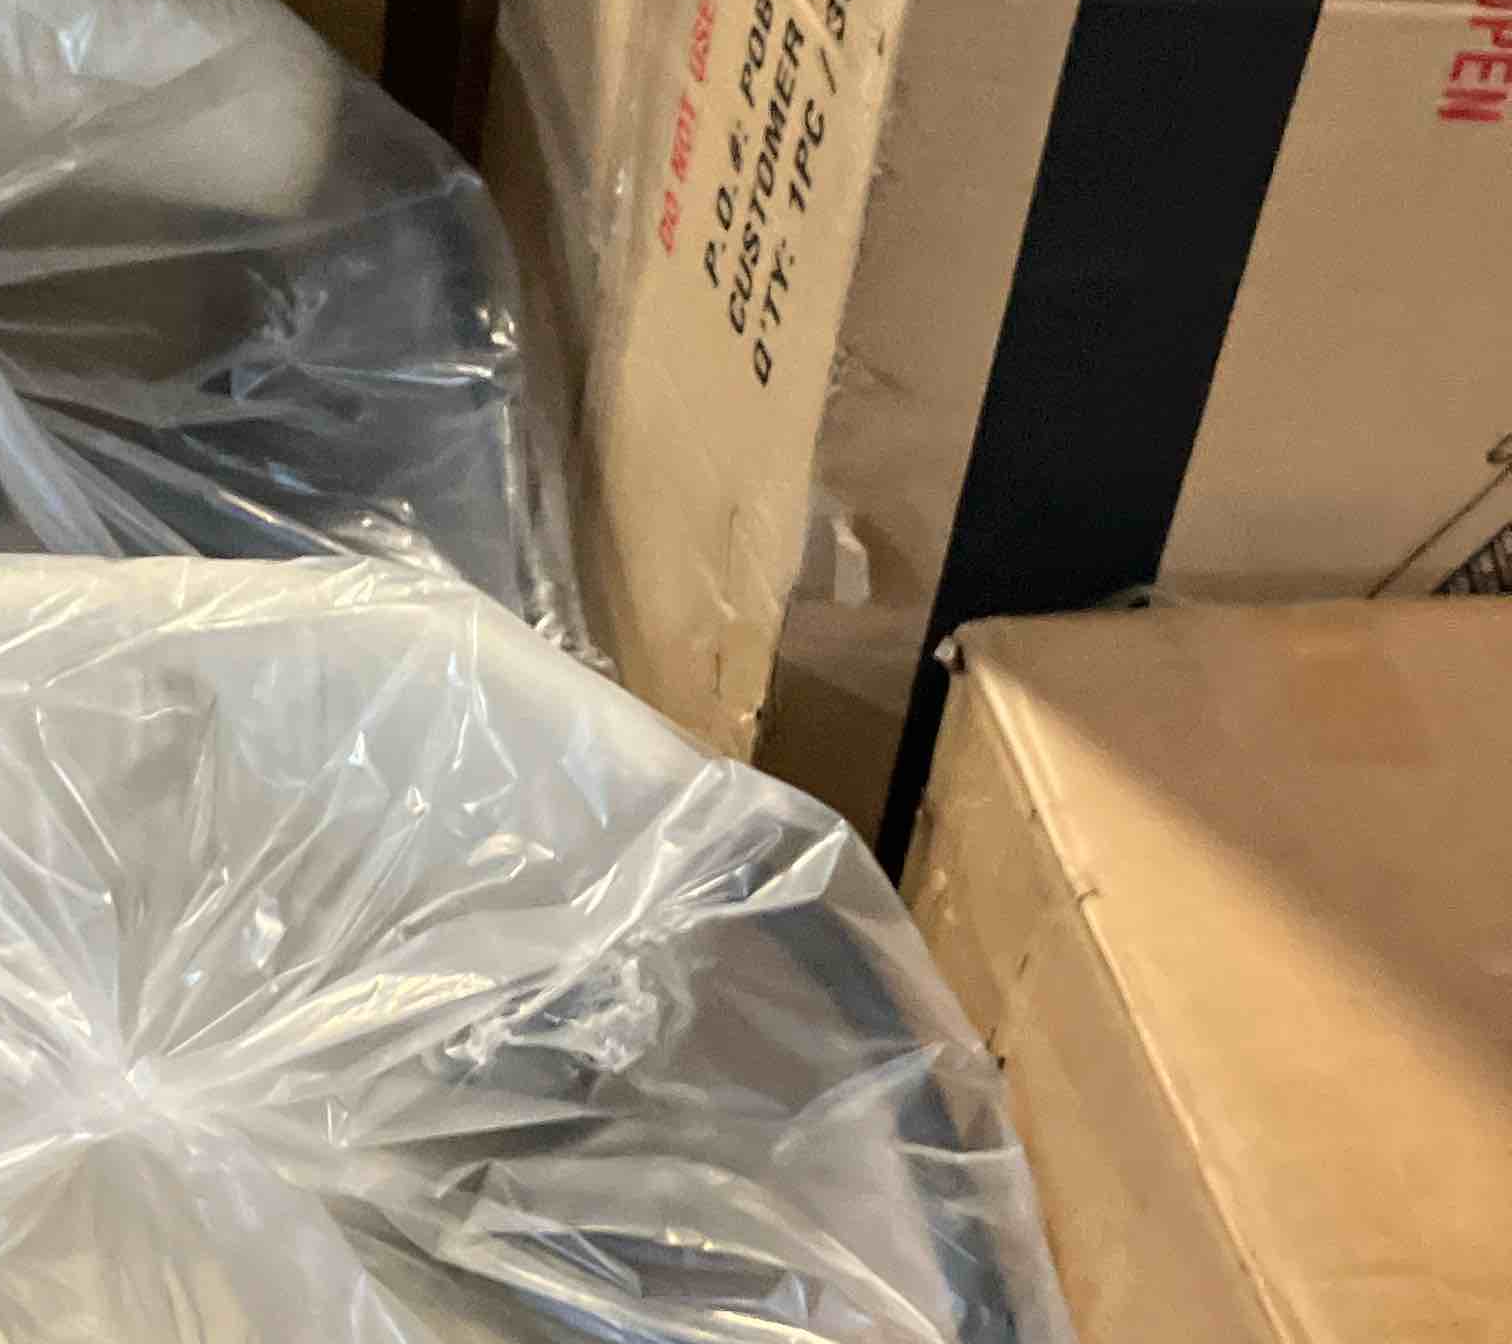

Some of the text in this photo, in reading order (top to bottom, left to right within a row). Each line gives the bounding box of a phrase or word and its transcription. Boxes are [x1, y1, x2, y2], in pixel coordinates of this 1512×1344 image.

[657, 189, 680, 255] DO
[668, 93, 696, 182] NOT
[703, 119, 748, 288] P.O.#:
[729, 16, 804, 334] CUSTOMER
[752, 236, 794, 386] Q'TY:
[787, 97, 826, 214] 1PC
[818, 46, 836, 94] /
